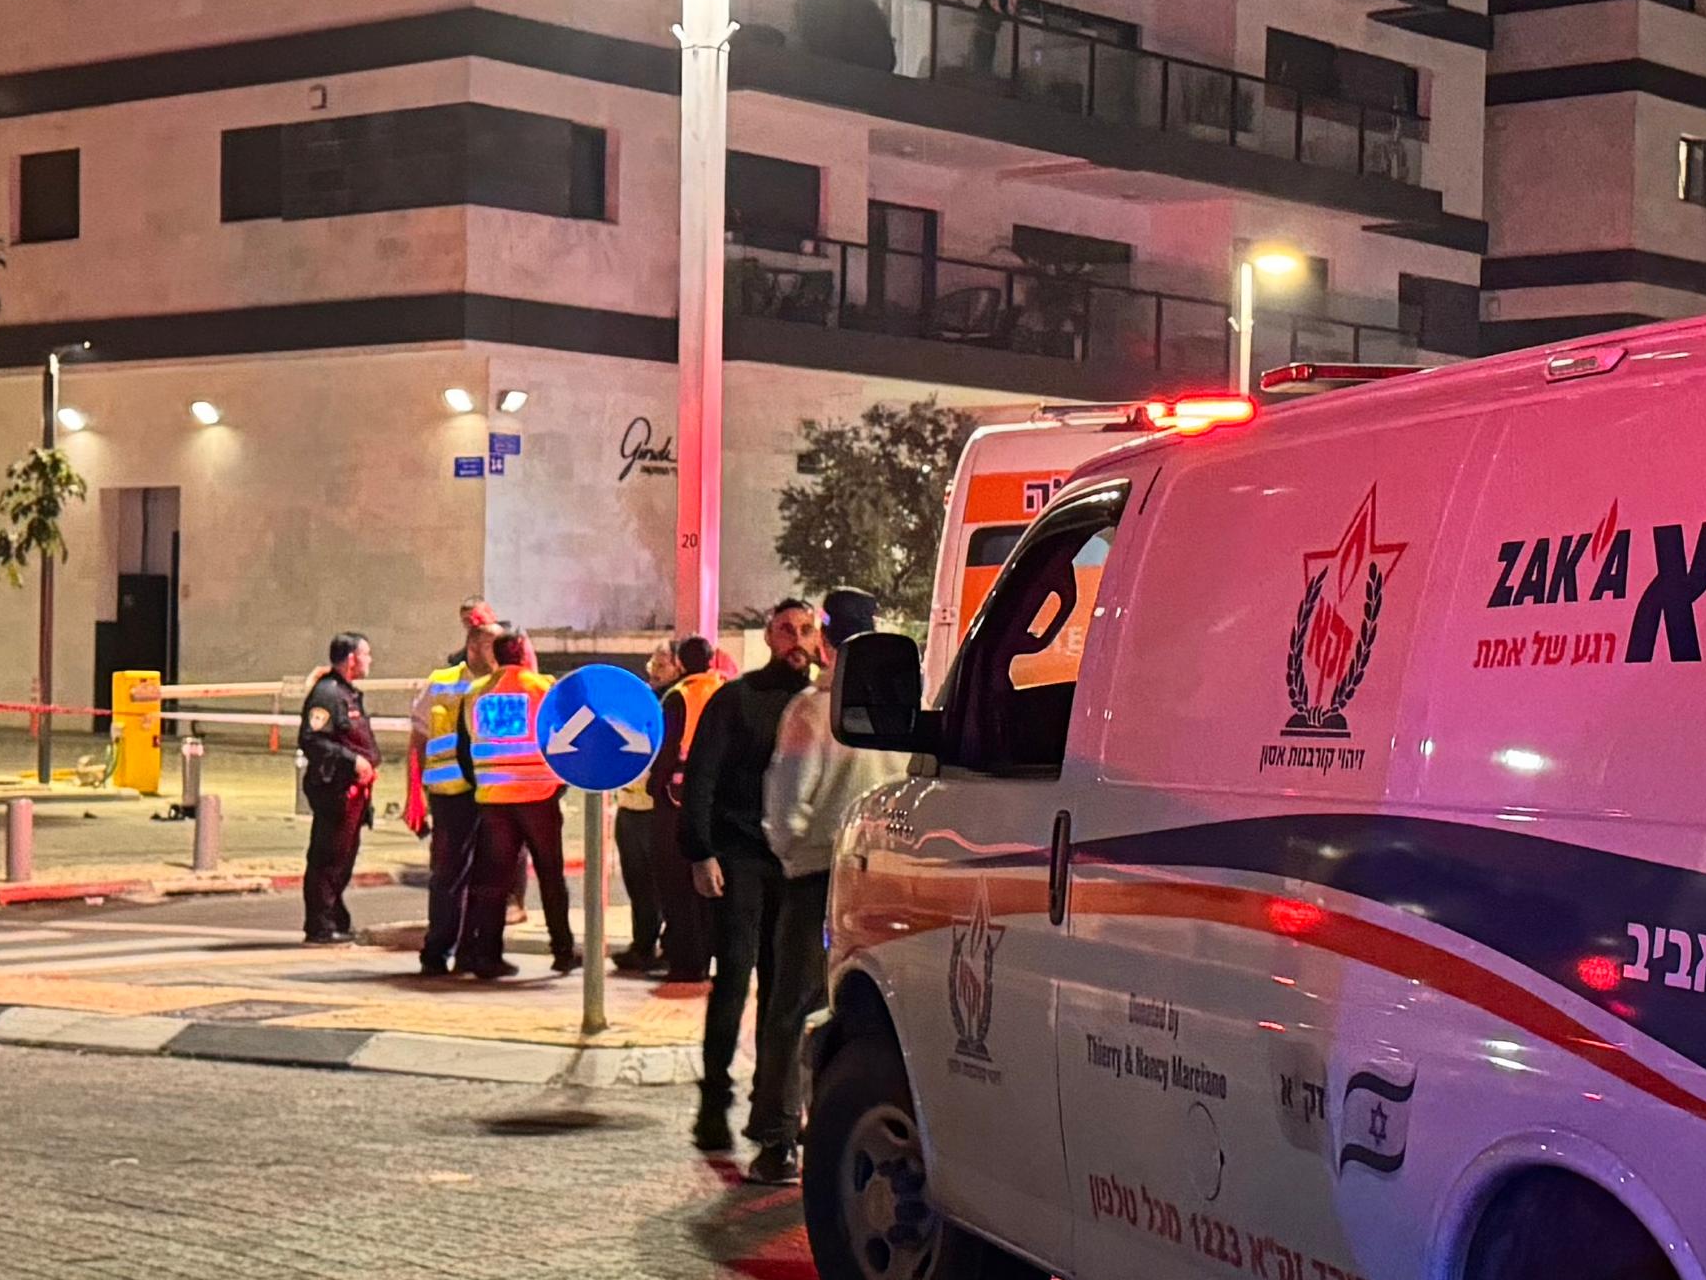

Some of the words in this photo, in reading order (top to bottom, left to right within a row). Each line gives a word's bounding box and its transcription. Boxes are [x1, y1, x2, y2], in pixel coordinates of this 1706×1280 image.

[682, 533, 698, 548] 20
[1473, 637, 1526, 668] אמת
[1531, 631, 1567, 666] של
[1570, 632, 1616, 665] רגע
[1259, 744, 1286, 773] אסון
[1287, 746, 1335, 776] קורבנות
[1338, 749, 1365, 770] זיהוי
[1089, 1174, 1138, 1226] טלפון
[1141, 1184, 1182, 1244] מכל
